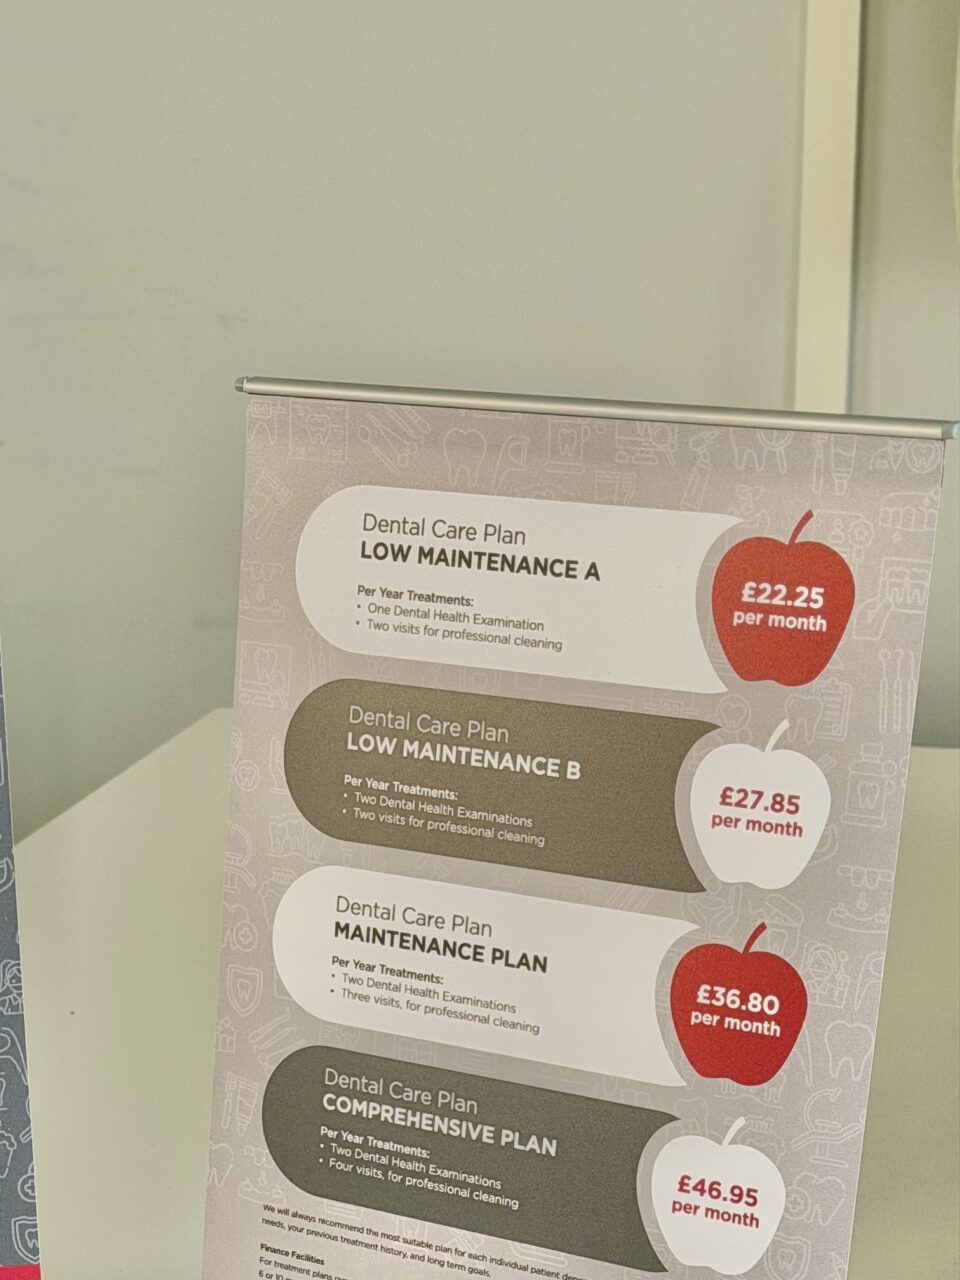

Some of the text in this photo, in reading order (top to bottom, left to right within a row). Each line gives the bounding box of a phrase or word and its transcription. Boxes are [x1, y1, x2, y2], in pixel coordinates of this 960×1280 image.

[363, 513, 525, 545] Dental Care Plan
[361, 541, 600, 581] LOW MAINTENANCE A
[357, 584, 473, 607] Per Year Treatments:
[741, 581, 824, 609] £22.25
[367, 602, 544, 631] One Dental Health Examination
[733, 611, 826, 631] per month
[349, 705, 508, 743] Dental Care Plan
[347, 732, 580, 779] LOW MAINTENANCE B
[719, 786, 800, 815] £27.85
[336, 895, 491, 937] Dental Care Plan
[334, 921, 547, 973] MAINTENANCE PLAN
[697, 984, 779, 1015] £36.80
[323, 1093, 556, 1156] COMPREHENSIVE PLAN
[329, 1157, 518, 1210] Four visits, for professional cleaning
[677, 1175, 758, 1207] £46.95
[671, 1200, 759, 1228] per month
[260, 1243, 324, 1265] Finance Facilities
